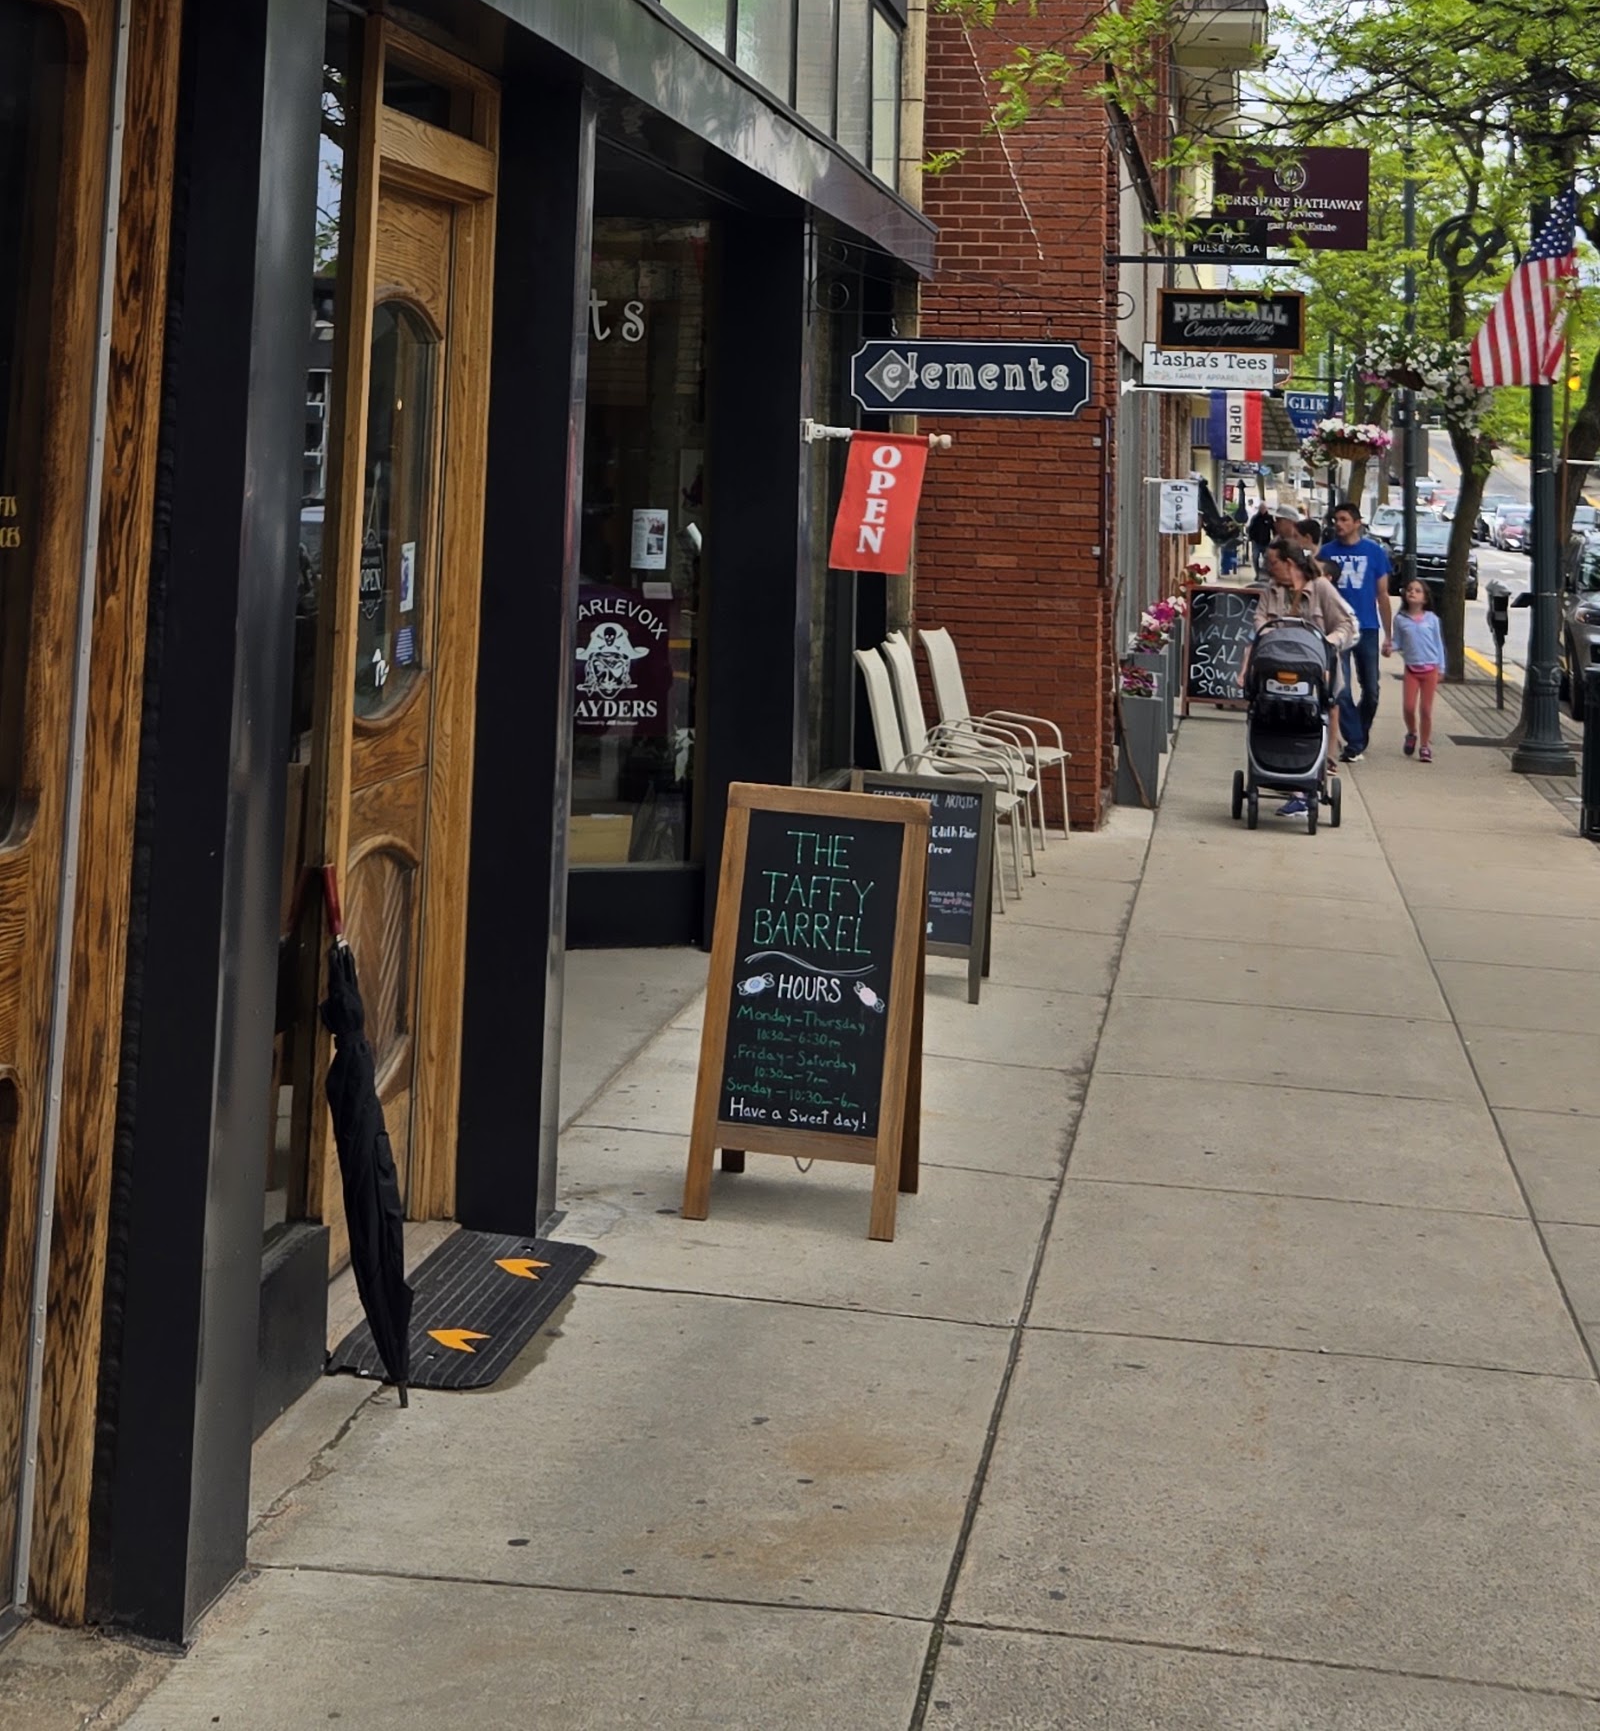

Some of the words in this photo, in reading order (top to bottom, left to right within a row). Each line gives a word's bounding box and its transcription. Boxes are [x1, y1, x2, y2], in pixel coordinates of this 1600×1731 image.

[1217, 194, 1290, 209] ERKSHIRE
[1292, 196, 1364, 212] HATHAWAY
[1308, 221, 1337, 233] Estate
[1192, 243, 1225, 254] PULSE
[880, 351, 1072, 393] elements
[1150, 350, 1219, 370] Tasha's
[1223, 354, 1268, 371] Tees
[1174, 372, 1202, 381] FAMILY
[1206, 374, 1240, 384] APPAREL
[1287, 396, 1330, 412] GLIK
[1229, 404, 1243, 445] OPEN
[855, 444, 903, 555] OPEN
[1173, 494, 1184, 532] OPEN
[577, 597, 669, 642] ARLEVOIX
[1192, 592, 1257, 628] SIDE
[1191, 625, 1250, 644] WALK
[1194, 644, 1240, 666] SAL
[573, 699, 659, 718] AYDERS
[787, 831, 855, 869] THE
[762, 870, 875, 915] TAFFY
[753, 908, 872, 955] BARREL
[777, 973, 842, 1004] HOURS
[729, 1096, 767, 1119] Have
[771, 1108, 783, 1120] a
[832, 1110, 867, 1133] day!
